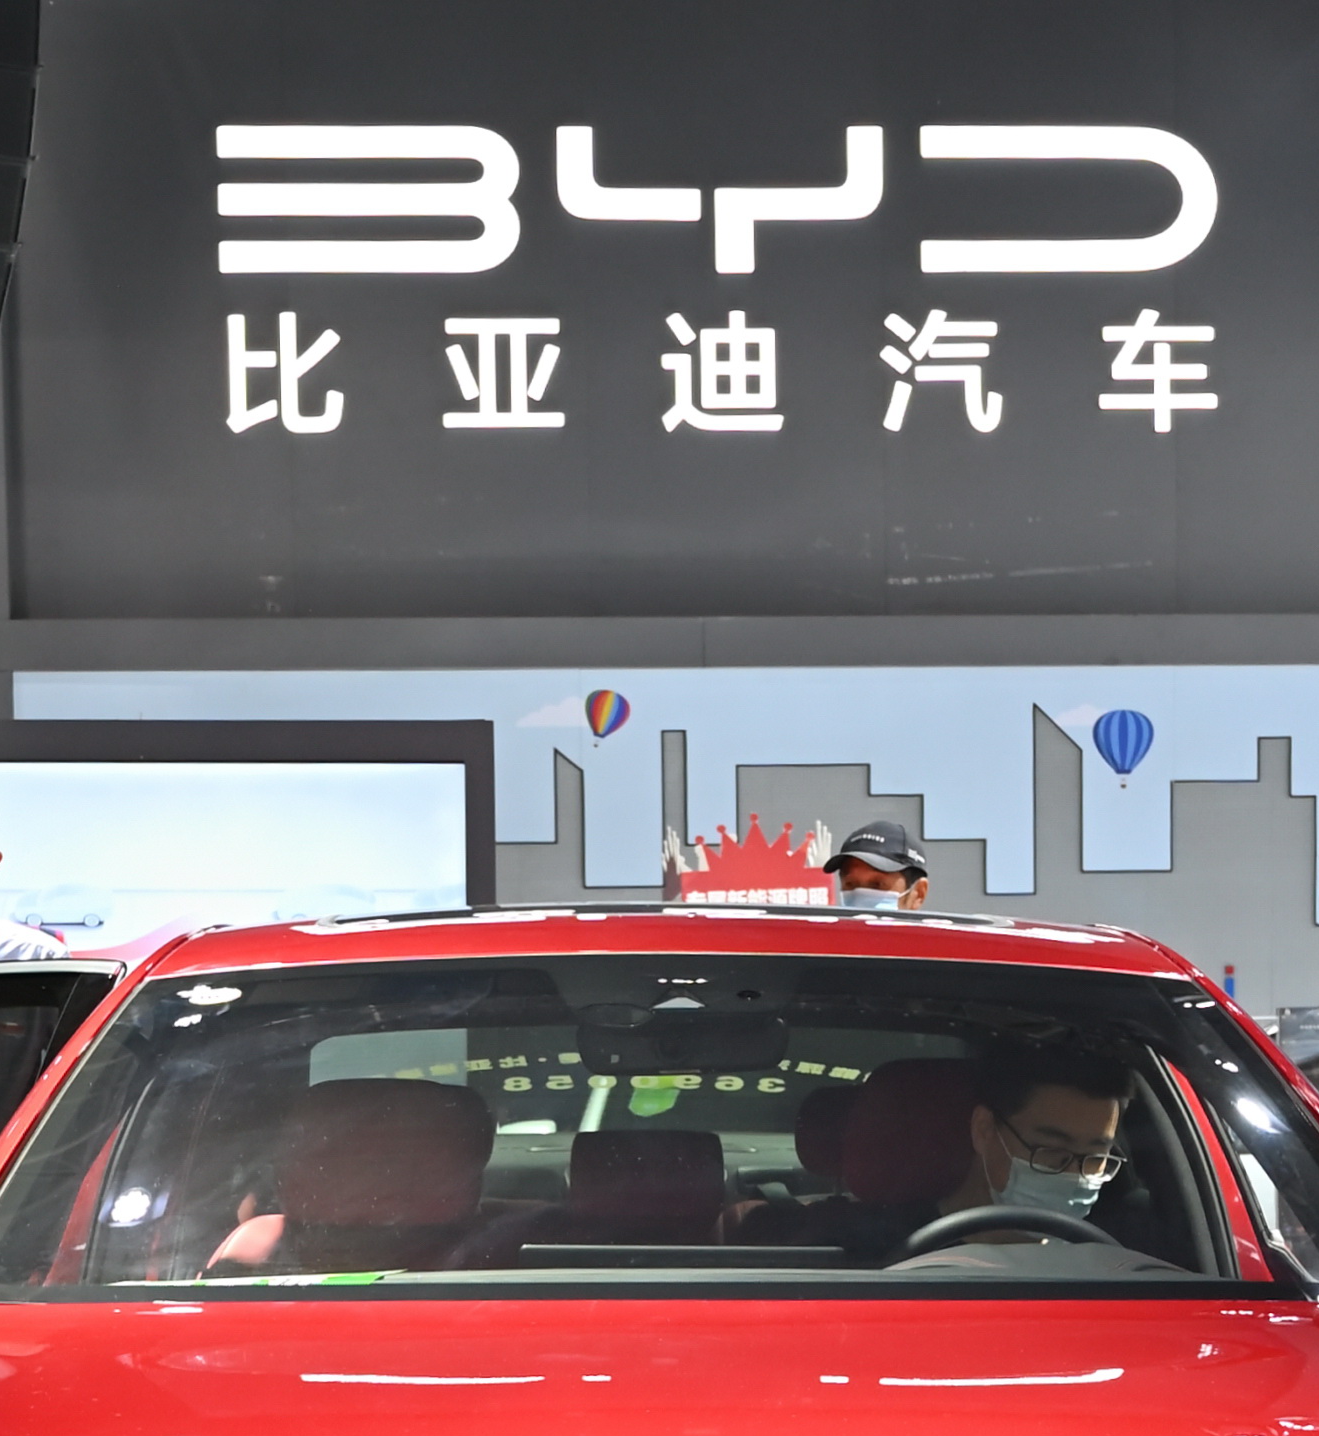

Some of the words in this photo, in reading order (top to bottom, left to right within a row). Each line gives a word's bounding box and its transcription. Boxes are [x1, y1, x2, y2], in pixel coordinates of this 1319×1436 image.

[216, 123, 1220, 276] BYD
[224, 307, 1220, 436] 比亚迪汽车
